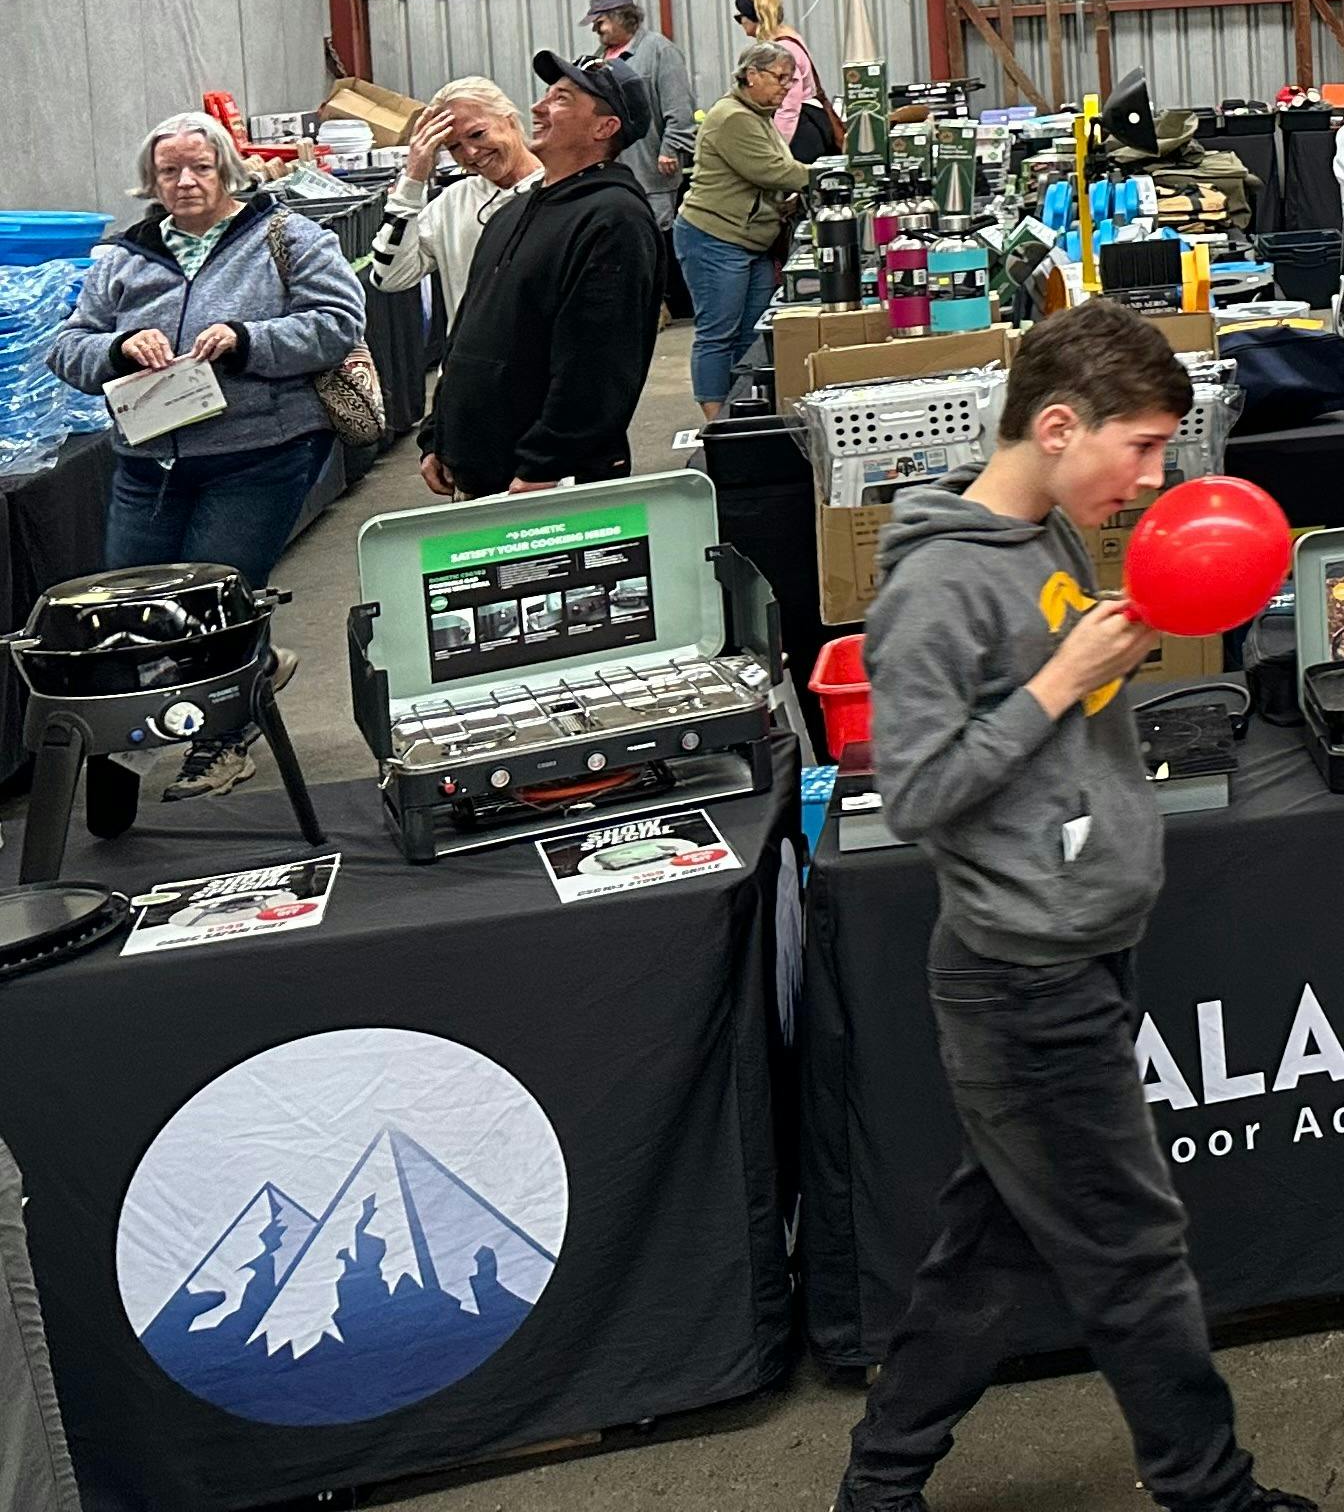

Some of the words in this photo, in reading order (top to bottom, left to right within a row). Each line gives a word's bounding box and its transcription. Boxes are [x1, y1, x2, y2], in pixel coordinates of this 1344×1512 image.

[520, 524, 566, 538] DOMETIC
[450, 548, 495, 564] SATISFY
[496, 541, 530, 556] YOUR
[530, 533, 584, 550] COOKING
[584, 526, 622, 542] NEEDS
[579, 825, 676, 852] SPECIAL
[585, 818, 664, 840] SHOW
[1171, 1121, 1261, 1164] oor
